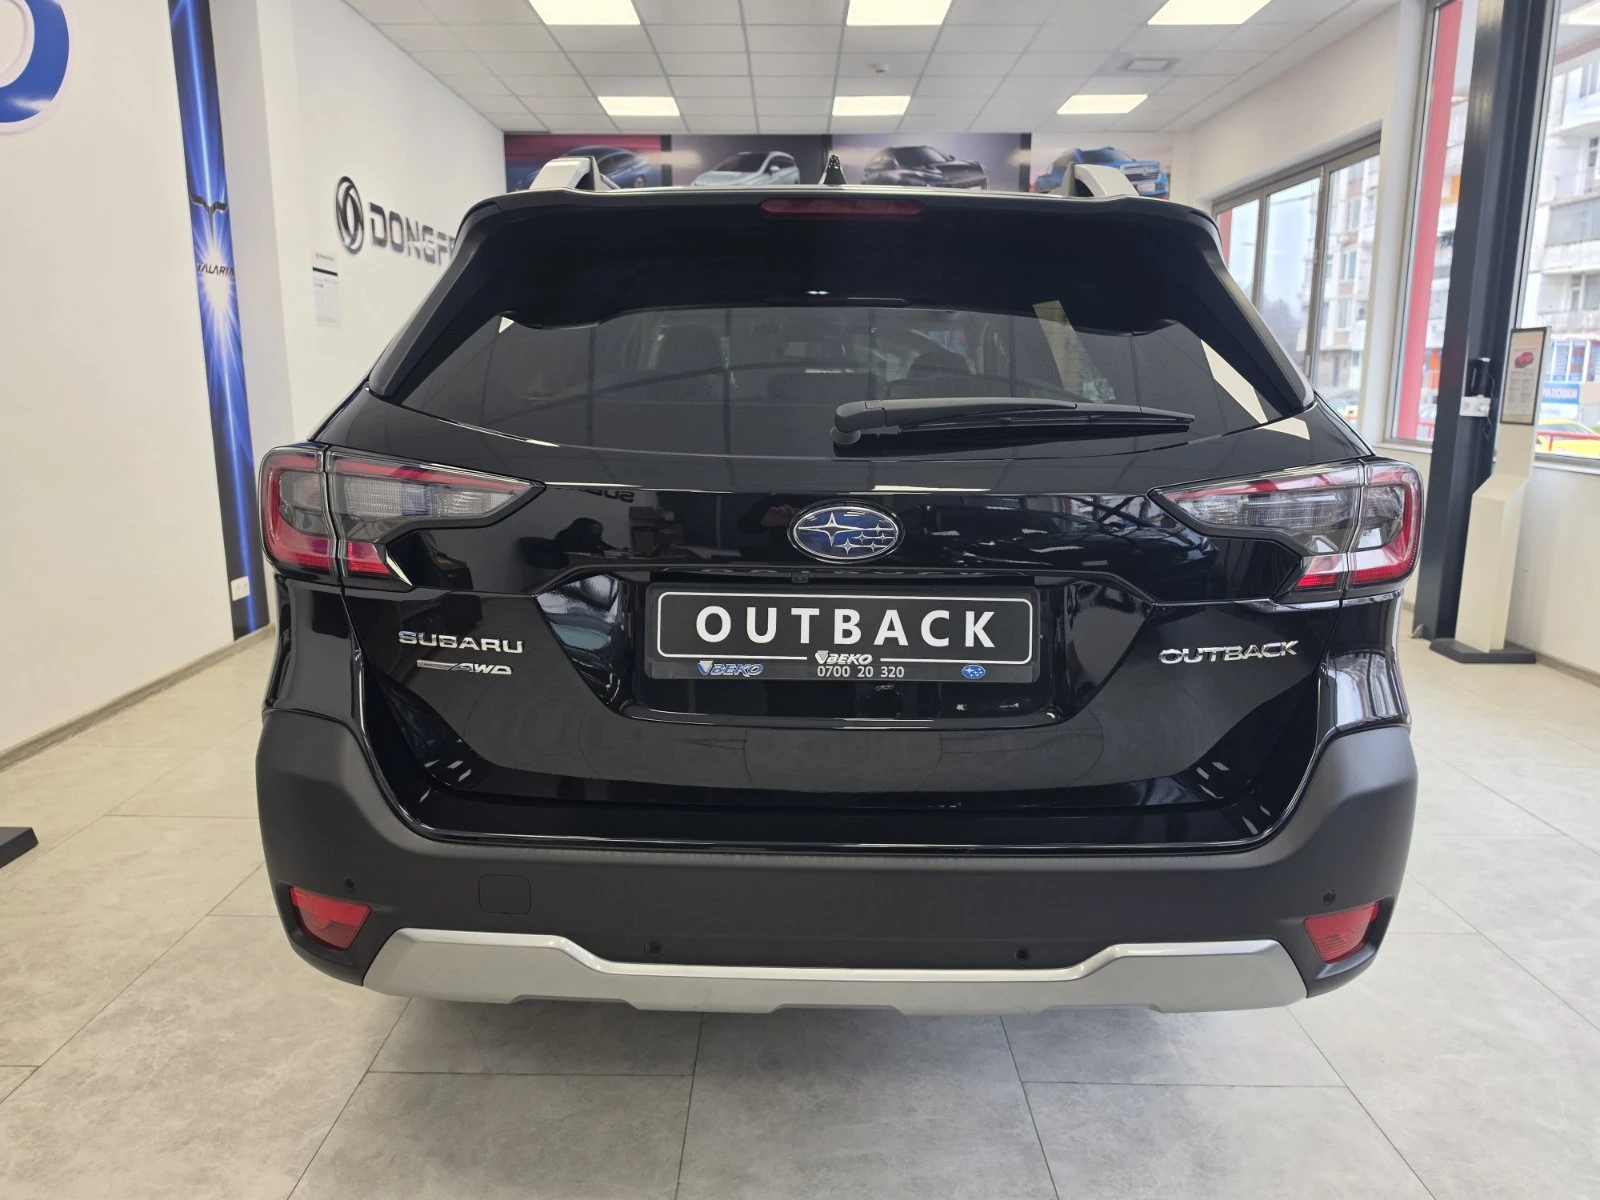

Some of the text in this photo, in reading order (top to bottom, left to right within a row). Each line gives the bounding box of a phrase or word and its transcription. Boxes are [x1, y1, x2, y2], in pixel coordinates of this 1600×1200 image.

[695, 605, 996, 648] OUTBACK
[398, 630, 524, 654] SUBARU
[823, 652, 873, 666] BEKO
[1159, 640, 1299, 665] OUTBACK
[450, 662, 512, 675] AWD
[709, 662, 764, 677] BEKO
[816, 665, 905, 678] 0700 20 320
